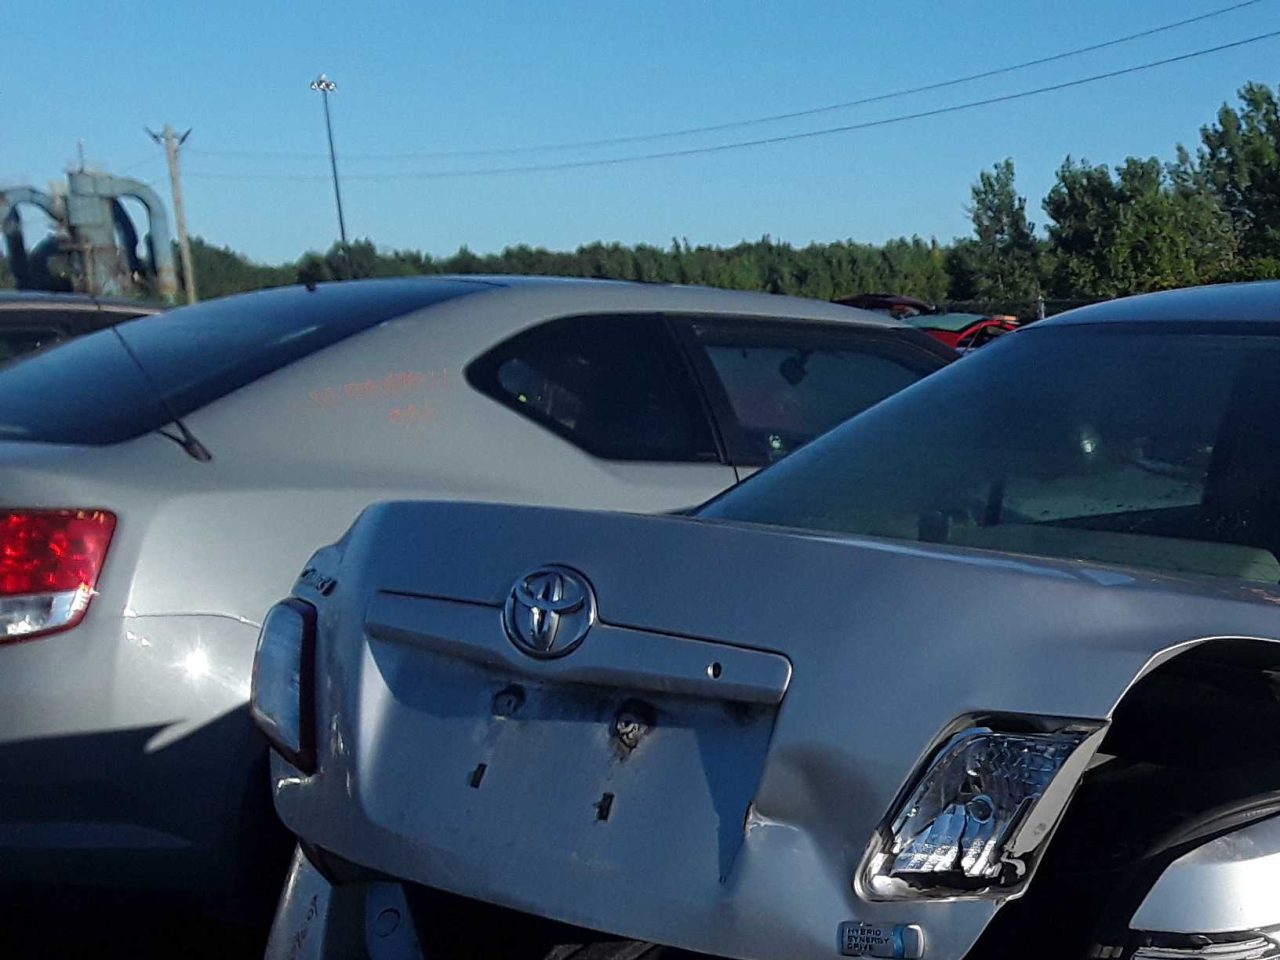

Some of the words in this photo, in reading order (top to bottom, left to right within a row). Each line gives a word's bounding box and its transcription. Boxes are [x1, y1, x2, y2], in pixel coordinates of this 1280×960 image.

[847, 928, 881, 936] HYBRID
[847, 935, 889, 944] SYNERGY
[846, 943, 873, 951] DRIVE
